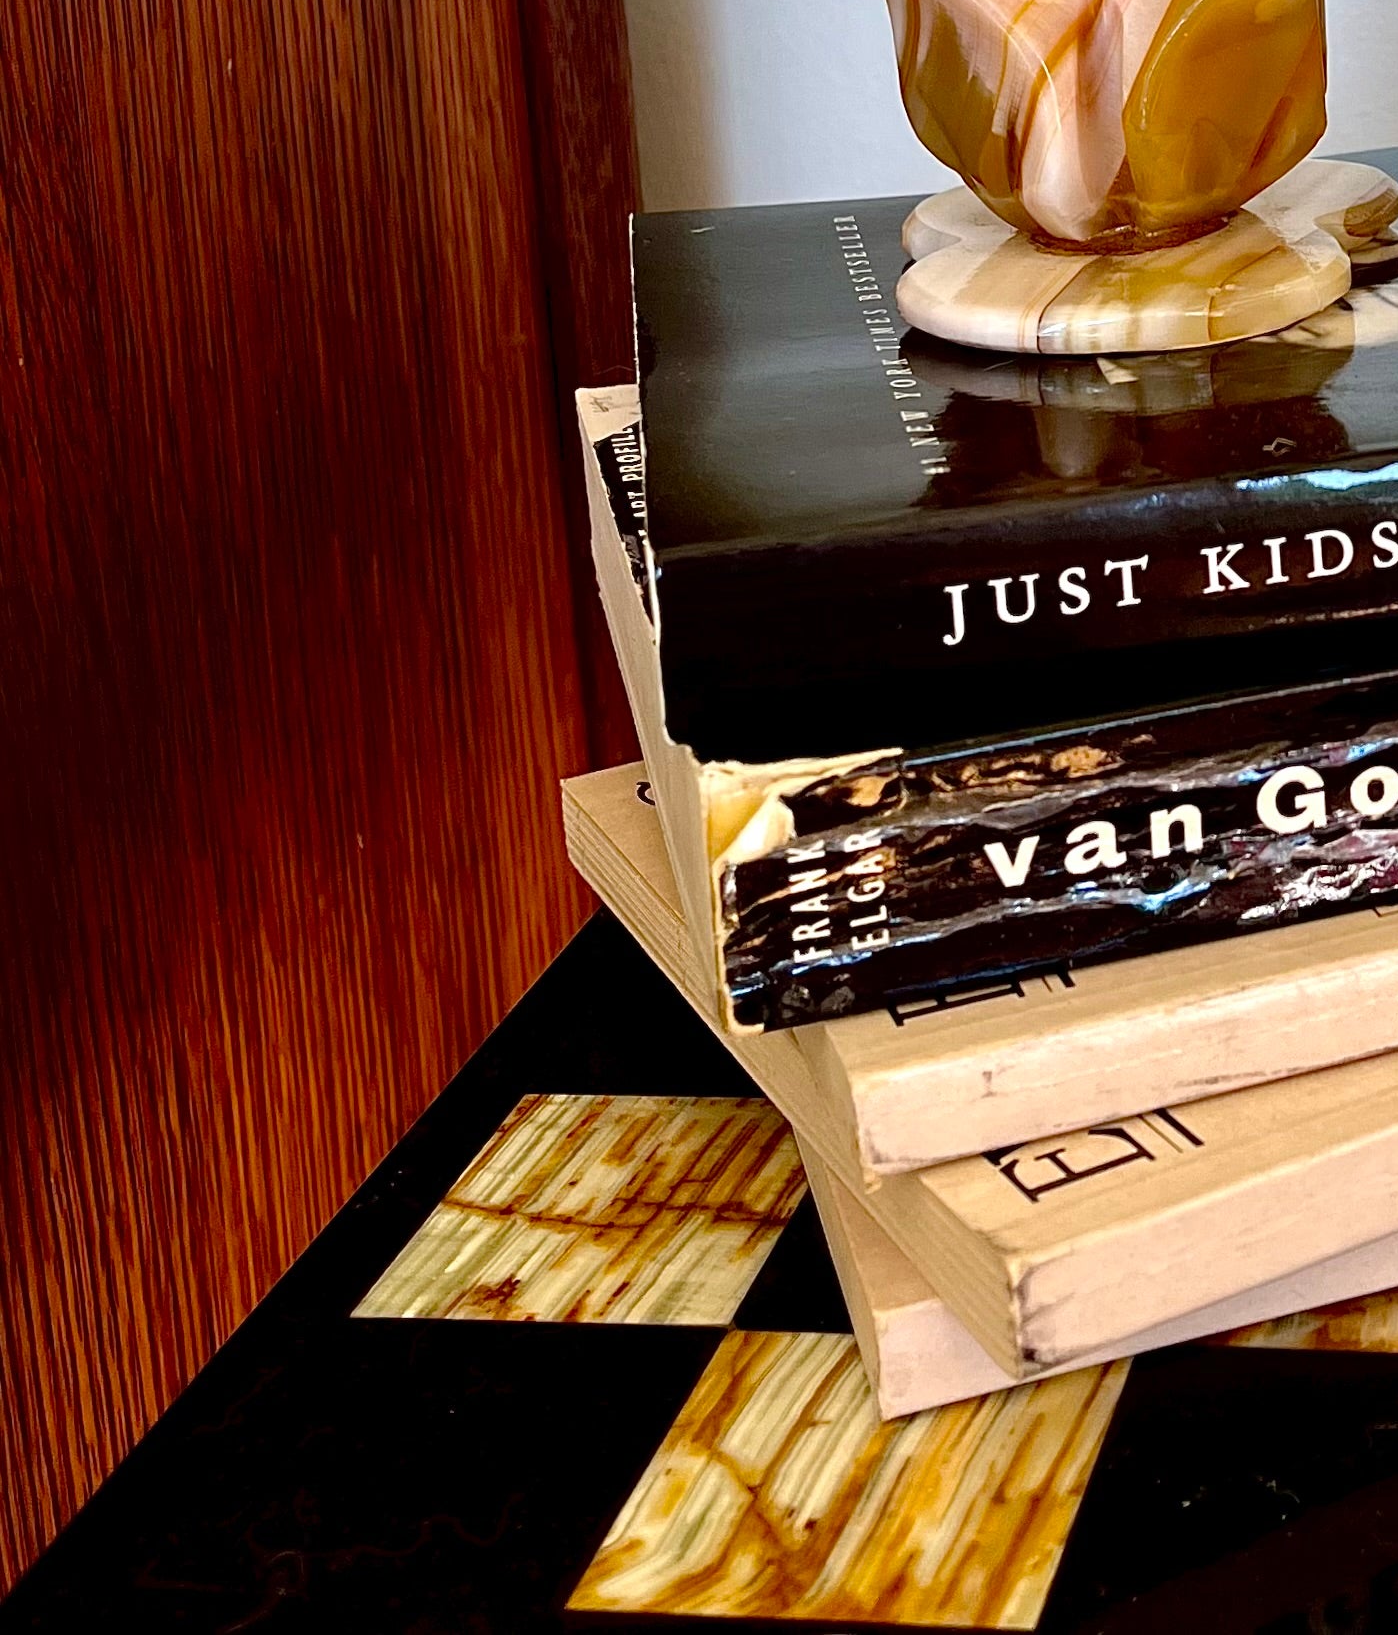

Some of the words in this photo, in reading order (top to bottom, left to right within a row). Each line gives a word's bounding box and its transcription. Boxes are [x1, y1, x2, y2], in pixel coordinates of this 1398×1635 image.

[833, 215, 883, 302] BESTSELLER
[862, 307, 902, 352] TIMES
[881, 357, 922, 400] YORK
[900, 410, 941, 448] NEW
[942, 553, 1150, 647] JUST
[843, 826, 890, 951] ELGAR
[983, 803, 1205, 888] van
[784, 838, 833, 965] FRANK
